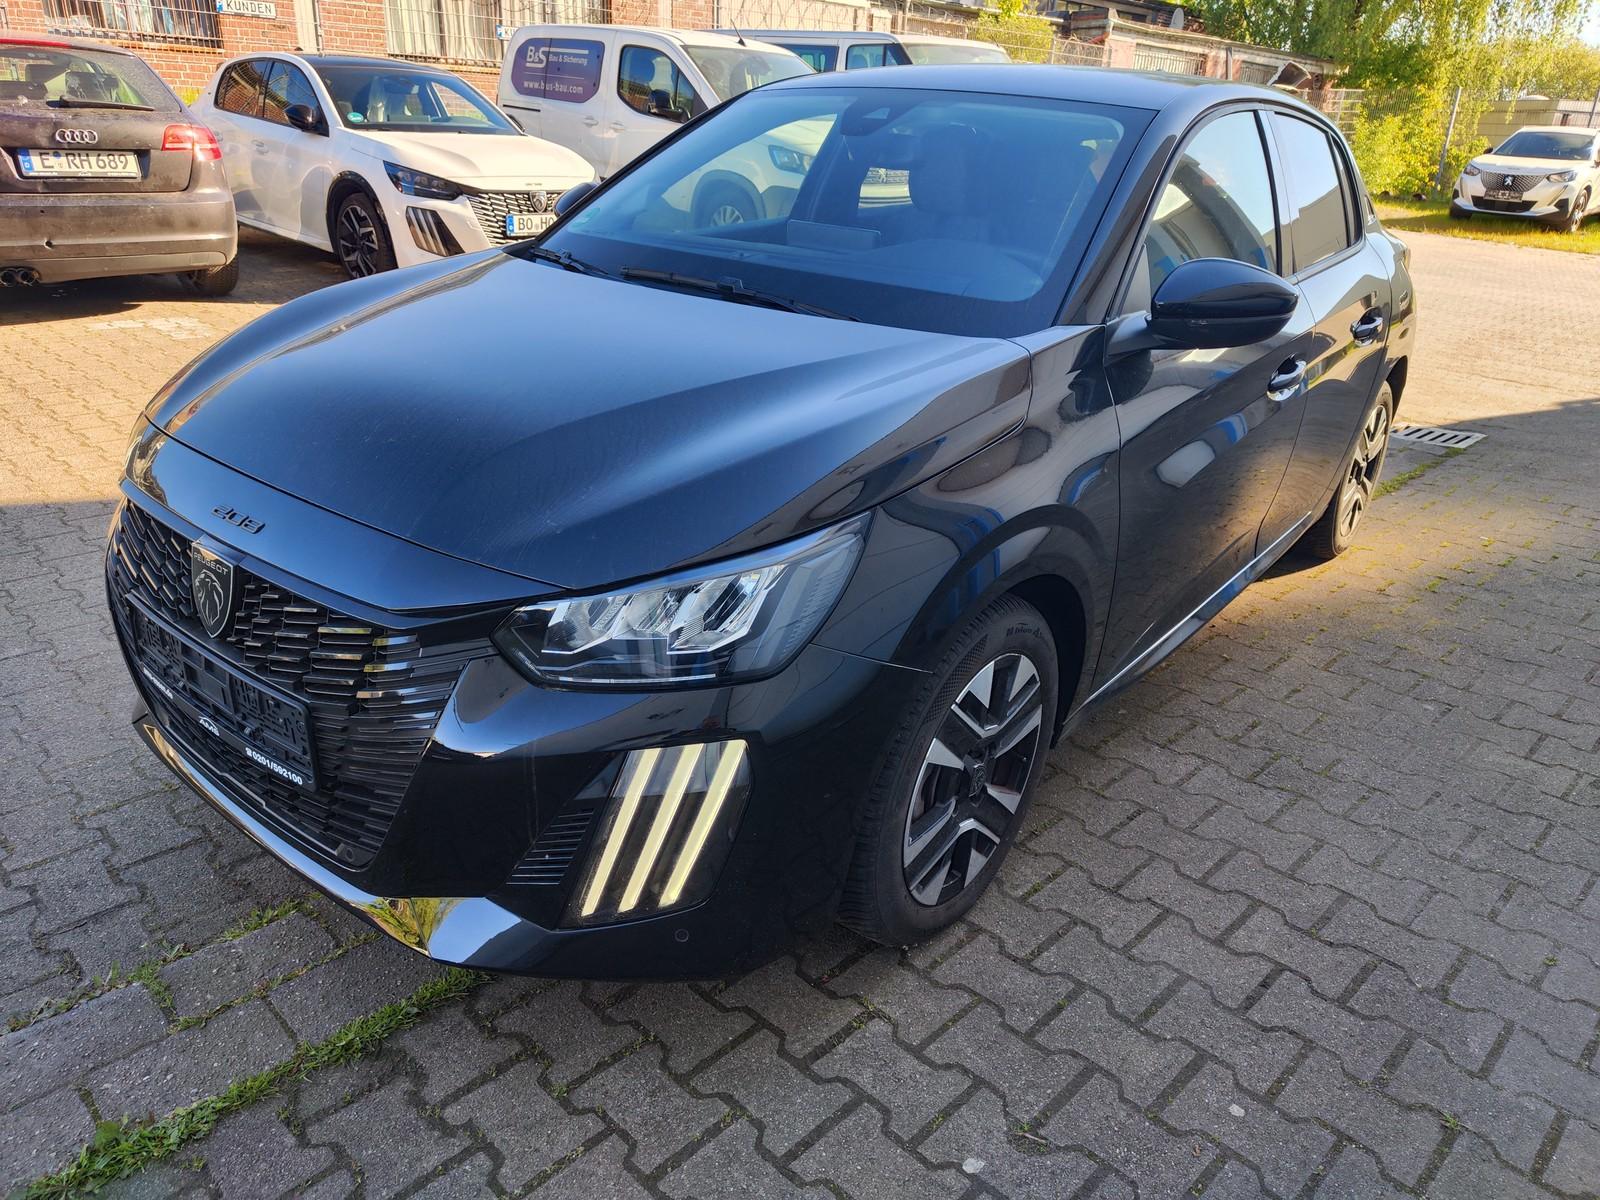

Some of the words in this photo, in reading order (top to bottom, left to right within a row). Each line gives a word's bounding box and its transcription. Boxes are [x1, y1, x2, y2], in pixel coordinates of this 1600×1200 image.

[226, 0, 272, 14] KUNDEN
[526, 46, 547, 68] B&S
[38, 152, 55, 169] E
[65, 152, 93, 169] RH
[96, 153, 129, 170] 689
[211, 505, 266, 535] 208
[193, 551, 229, 576] PEUGEOT
[252, 751, 303, 785] 0201/592100
